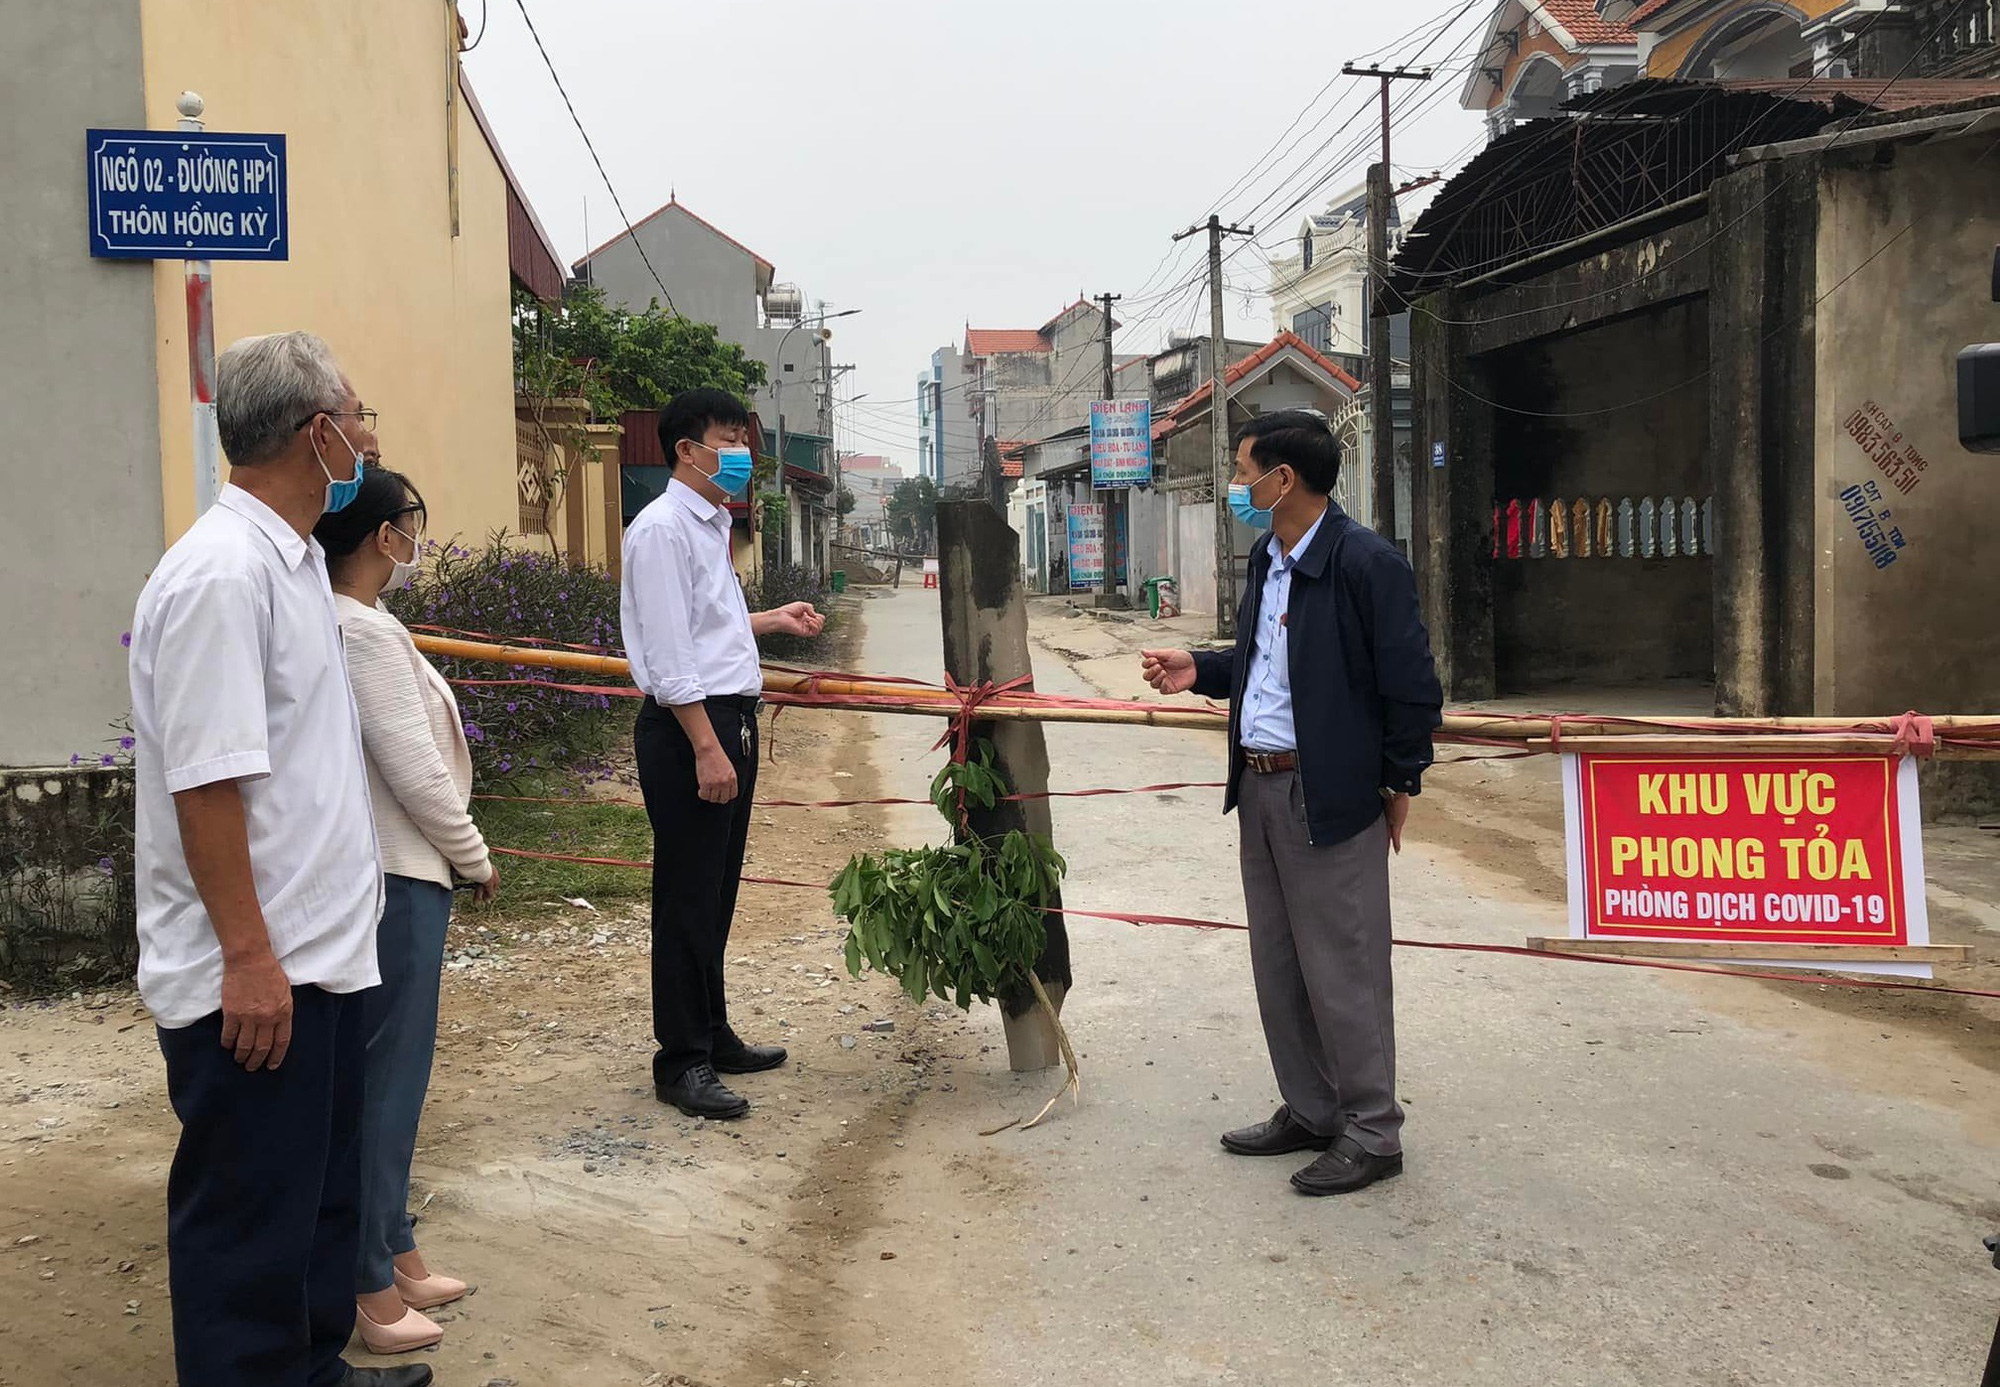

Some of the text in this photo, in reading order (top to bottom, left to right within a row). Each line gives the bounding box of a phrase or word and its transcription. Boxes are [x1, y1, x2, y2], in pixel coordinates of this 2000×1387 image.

[102, 147, 139, 192] NGÕ
[144, 158, 164, 192] 02
[177, 148, 238, 194] ĐƯỜNG
[243, 159, 273, 195] HP1
[108, 201, 269, 236] THÔN HỒNG KỲ
[1863, 480, 1882, 502] CAT
[1638, 768, 1836, 824] KHU VỰC
[1611, 823, 1873, 880] PHONG TỎA
[1605, 884, 1885, 927] PHÒNG DỊCH COVID-19
